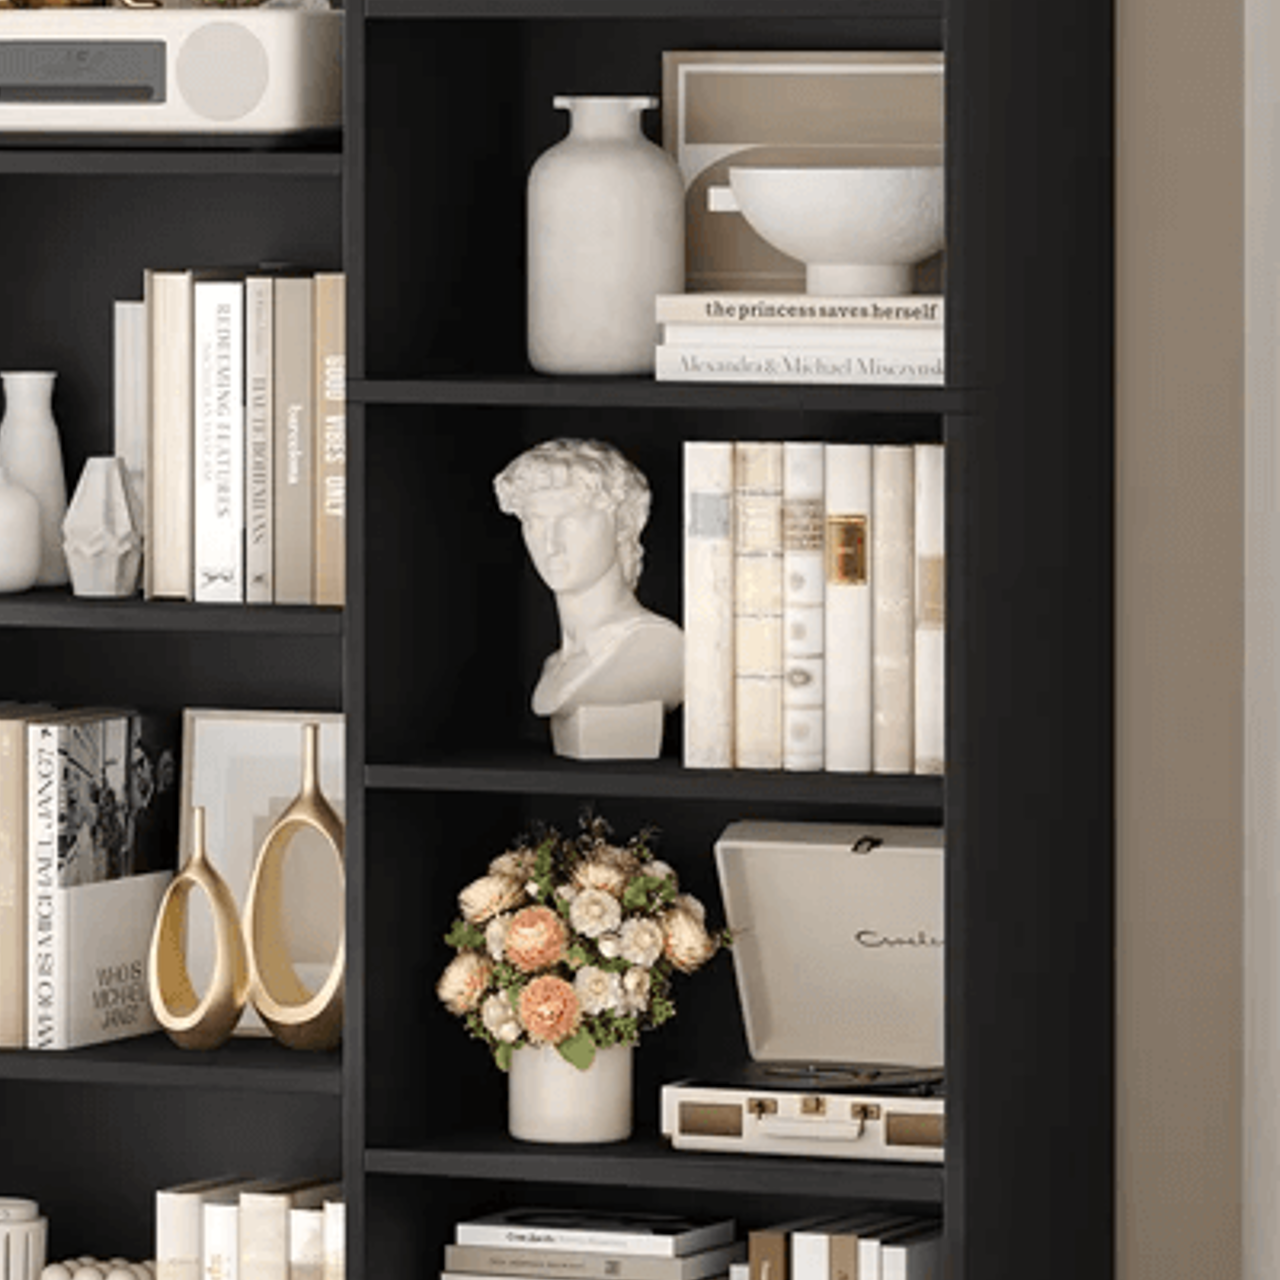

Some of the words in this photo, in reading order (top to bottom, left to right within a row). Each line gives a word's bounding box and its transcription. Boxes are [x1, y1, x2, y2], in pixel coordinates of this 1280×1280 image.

[705, 302, 735, 318] the
[738, 302, 815, 321] princess
[818, 306, 872, 319] saves
[873, 303, 939, 320] herself
[216, 303, 232, 417] REDEEMING
[325, 353, 346, 401] GOOD
[680, 355, 762, 374] Alexandra
[763, 360, 779, 374] &
[784, 356, 853, 375] Michael
[325, 415, 346, 464] VIBES
[216, 423, 232, 518] FEATURES
[37, 834, 54, 948] MICHAEL
[37, 953, 54, 977] IS
[37, 982, 54, 1049] WHO
